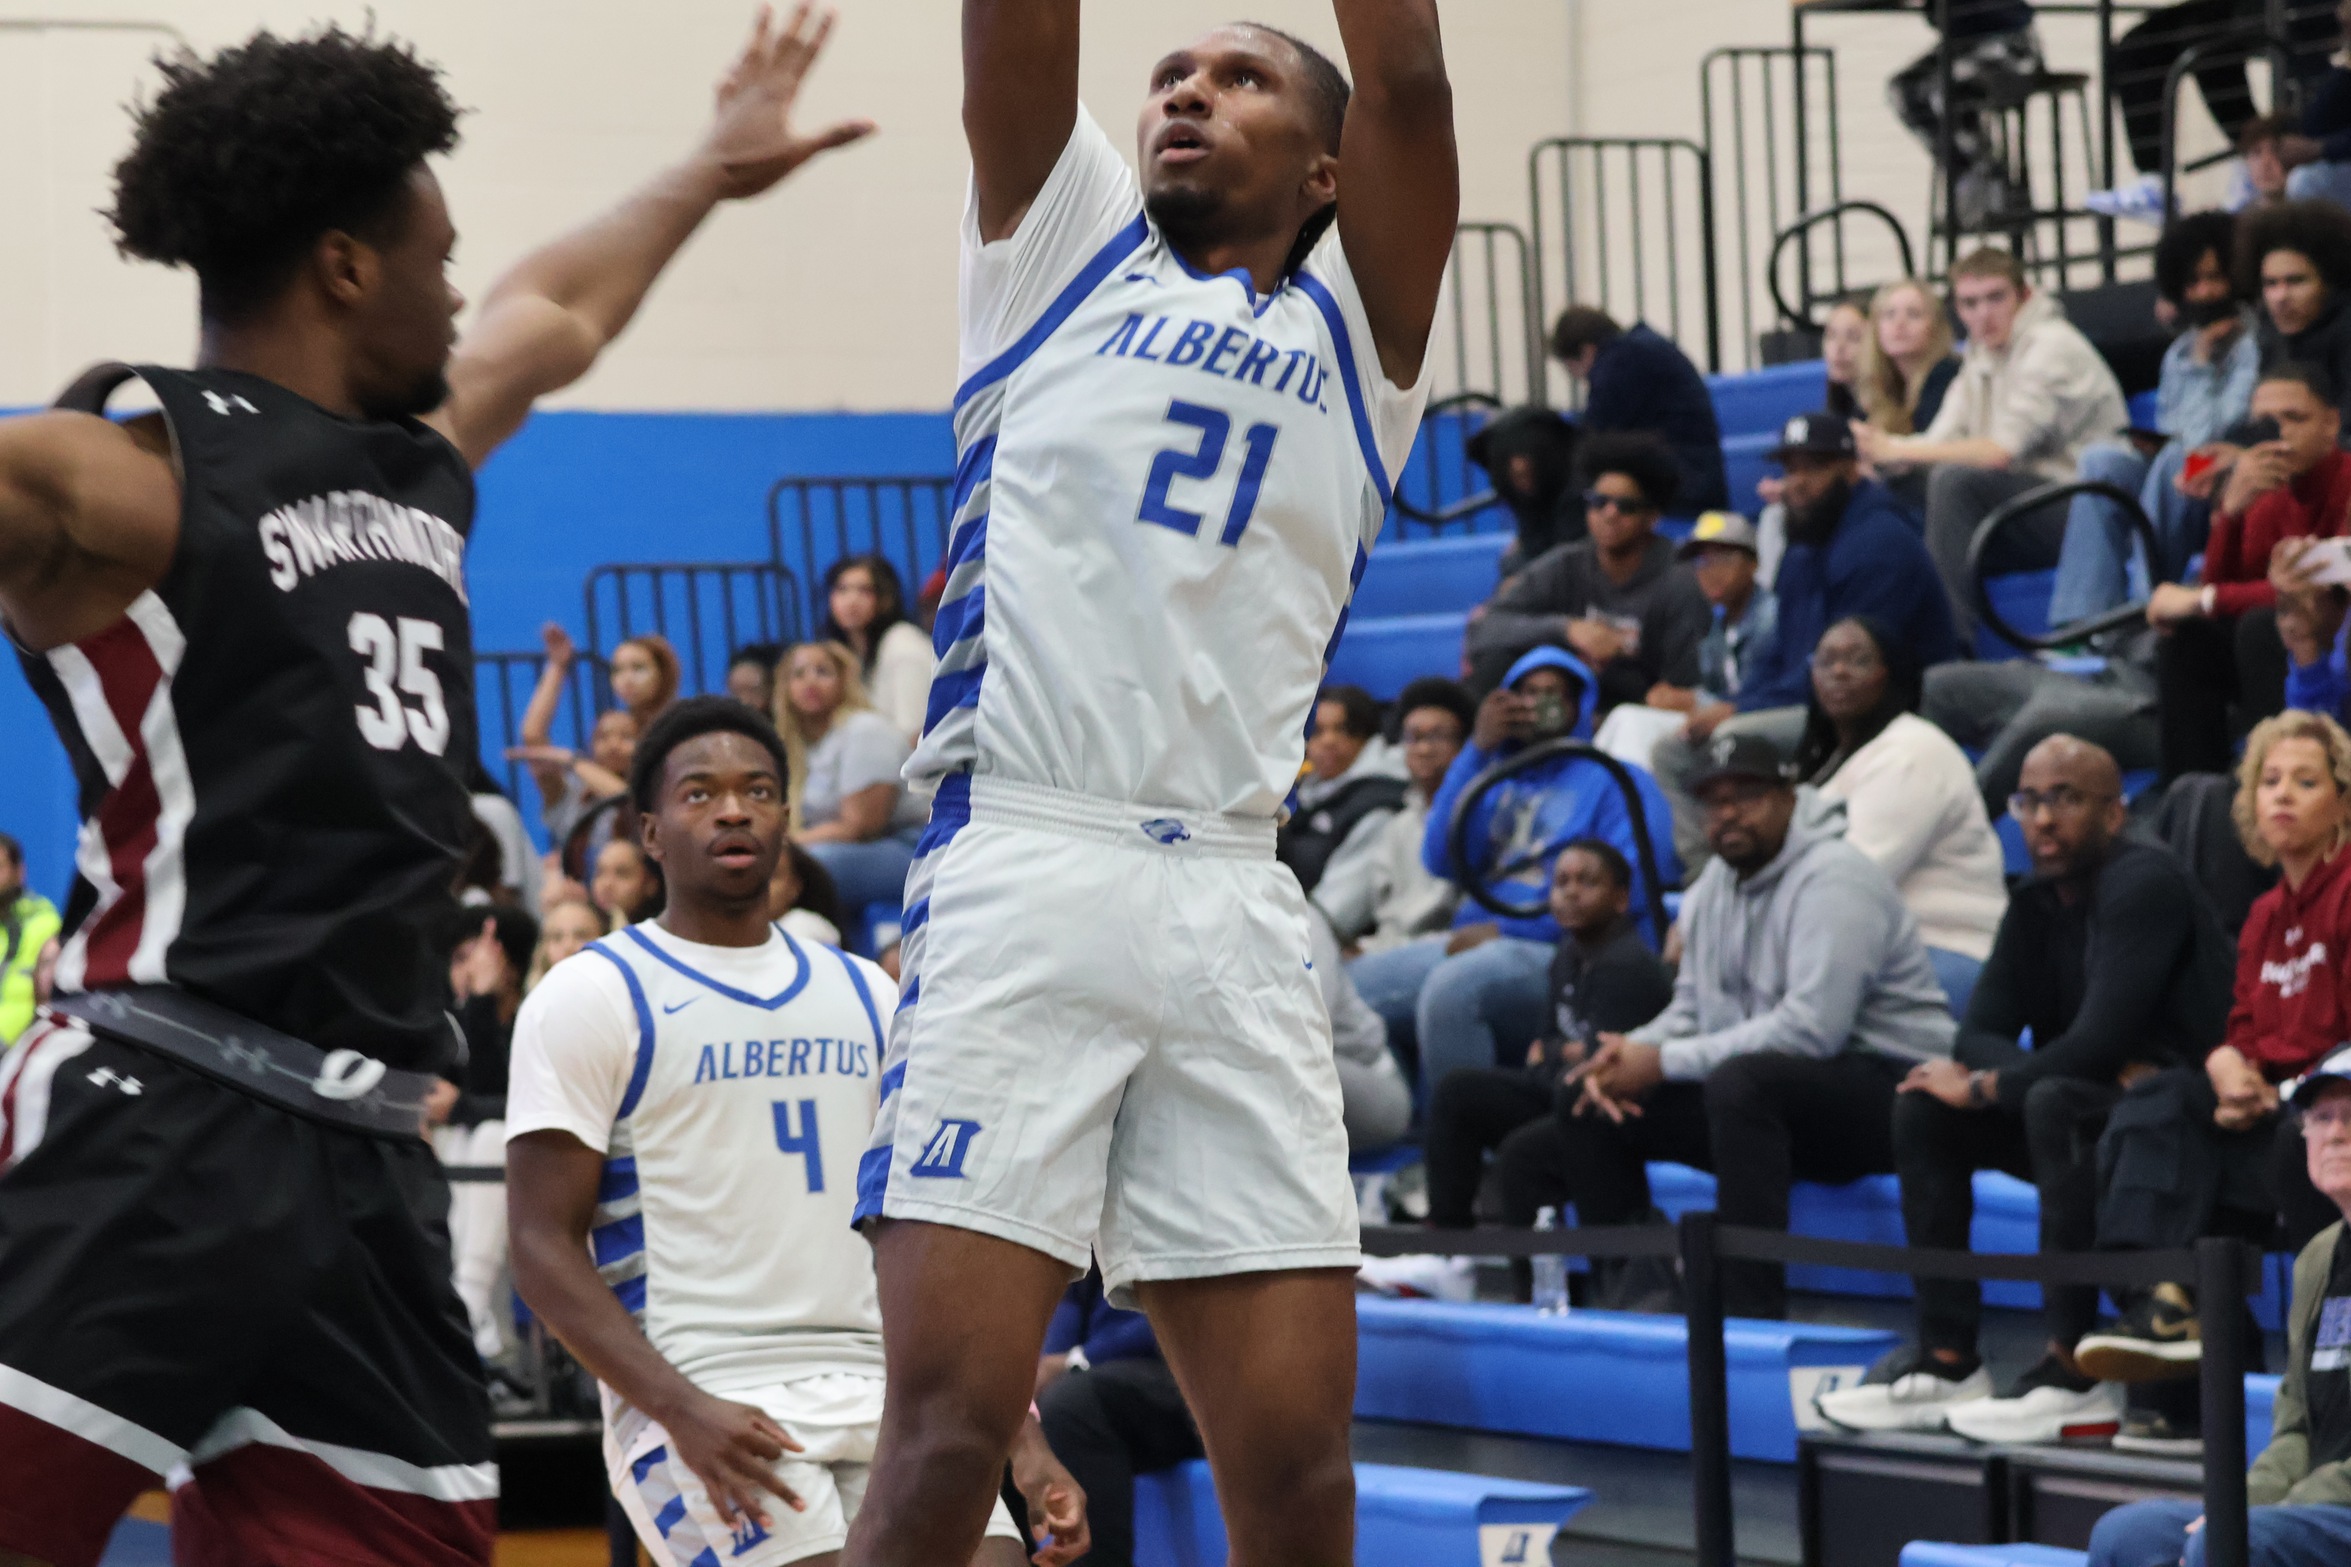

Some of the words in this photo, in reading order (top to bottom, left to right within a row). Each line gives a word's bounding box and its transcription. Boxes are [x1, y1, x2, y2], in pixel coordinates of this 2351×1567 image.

[1133, 395, 1281, 548] 21
[346, 611, 450, 757] 35
[694, 1038, 869, 1085] ALBERTUS
[771, 1099, 825, 1193] 4
